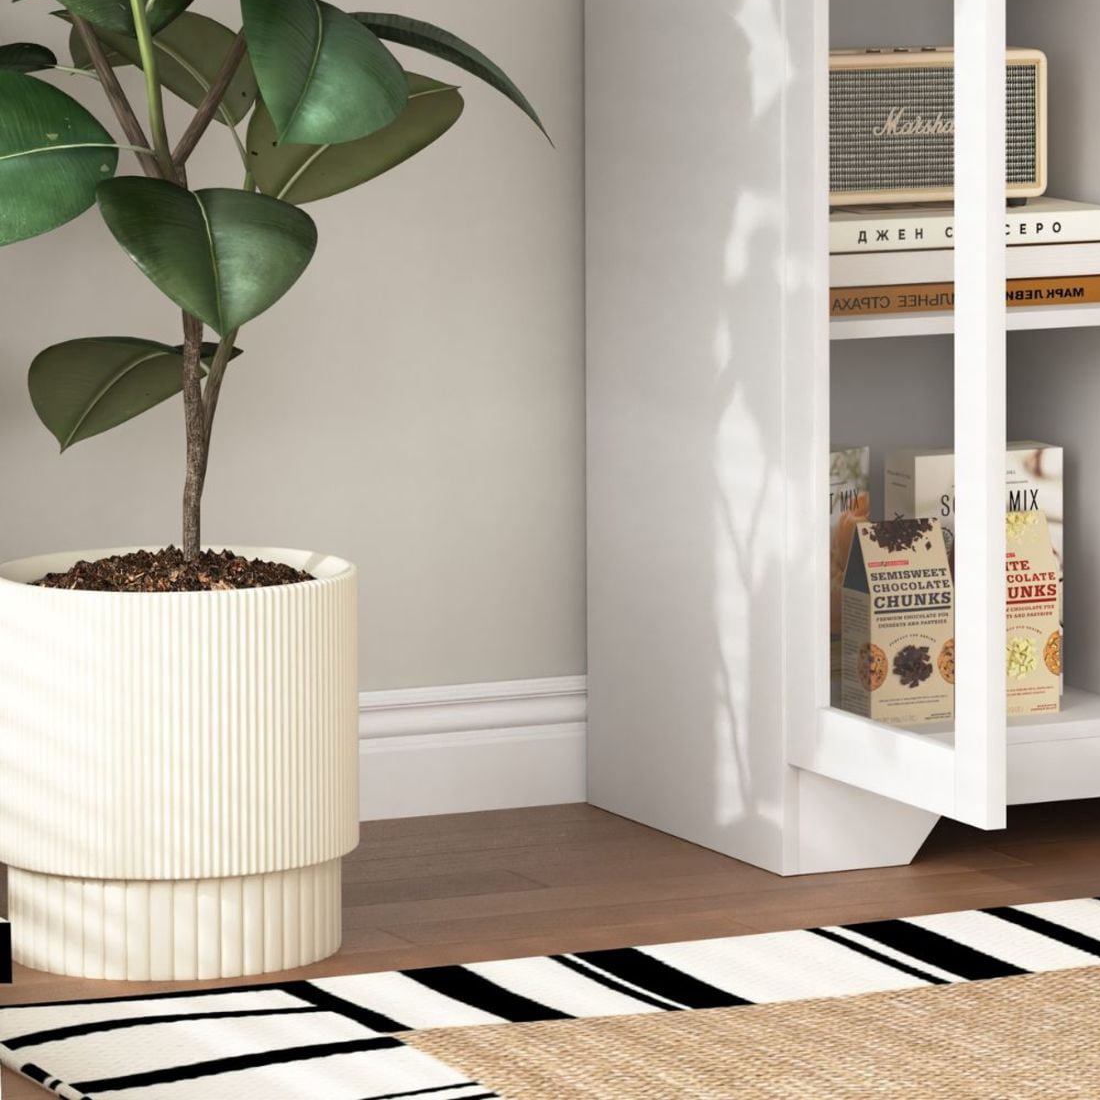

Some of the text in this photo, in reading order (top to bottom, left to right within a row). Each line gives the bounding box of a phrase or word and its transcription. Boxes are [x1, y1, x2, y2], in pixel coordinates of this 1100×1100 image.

[857, 228, 924, 244] ДЖЕН
[840, 488, 860, 511] MIX
[1009, 488, 1039, 512] MIX
[870, 567, 947, 581] SEMISWEET
[872, 579, 950, 593] CHOCOLATE
[874, 591, 951, 609] CHUNKS
